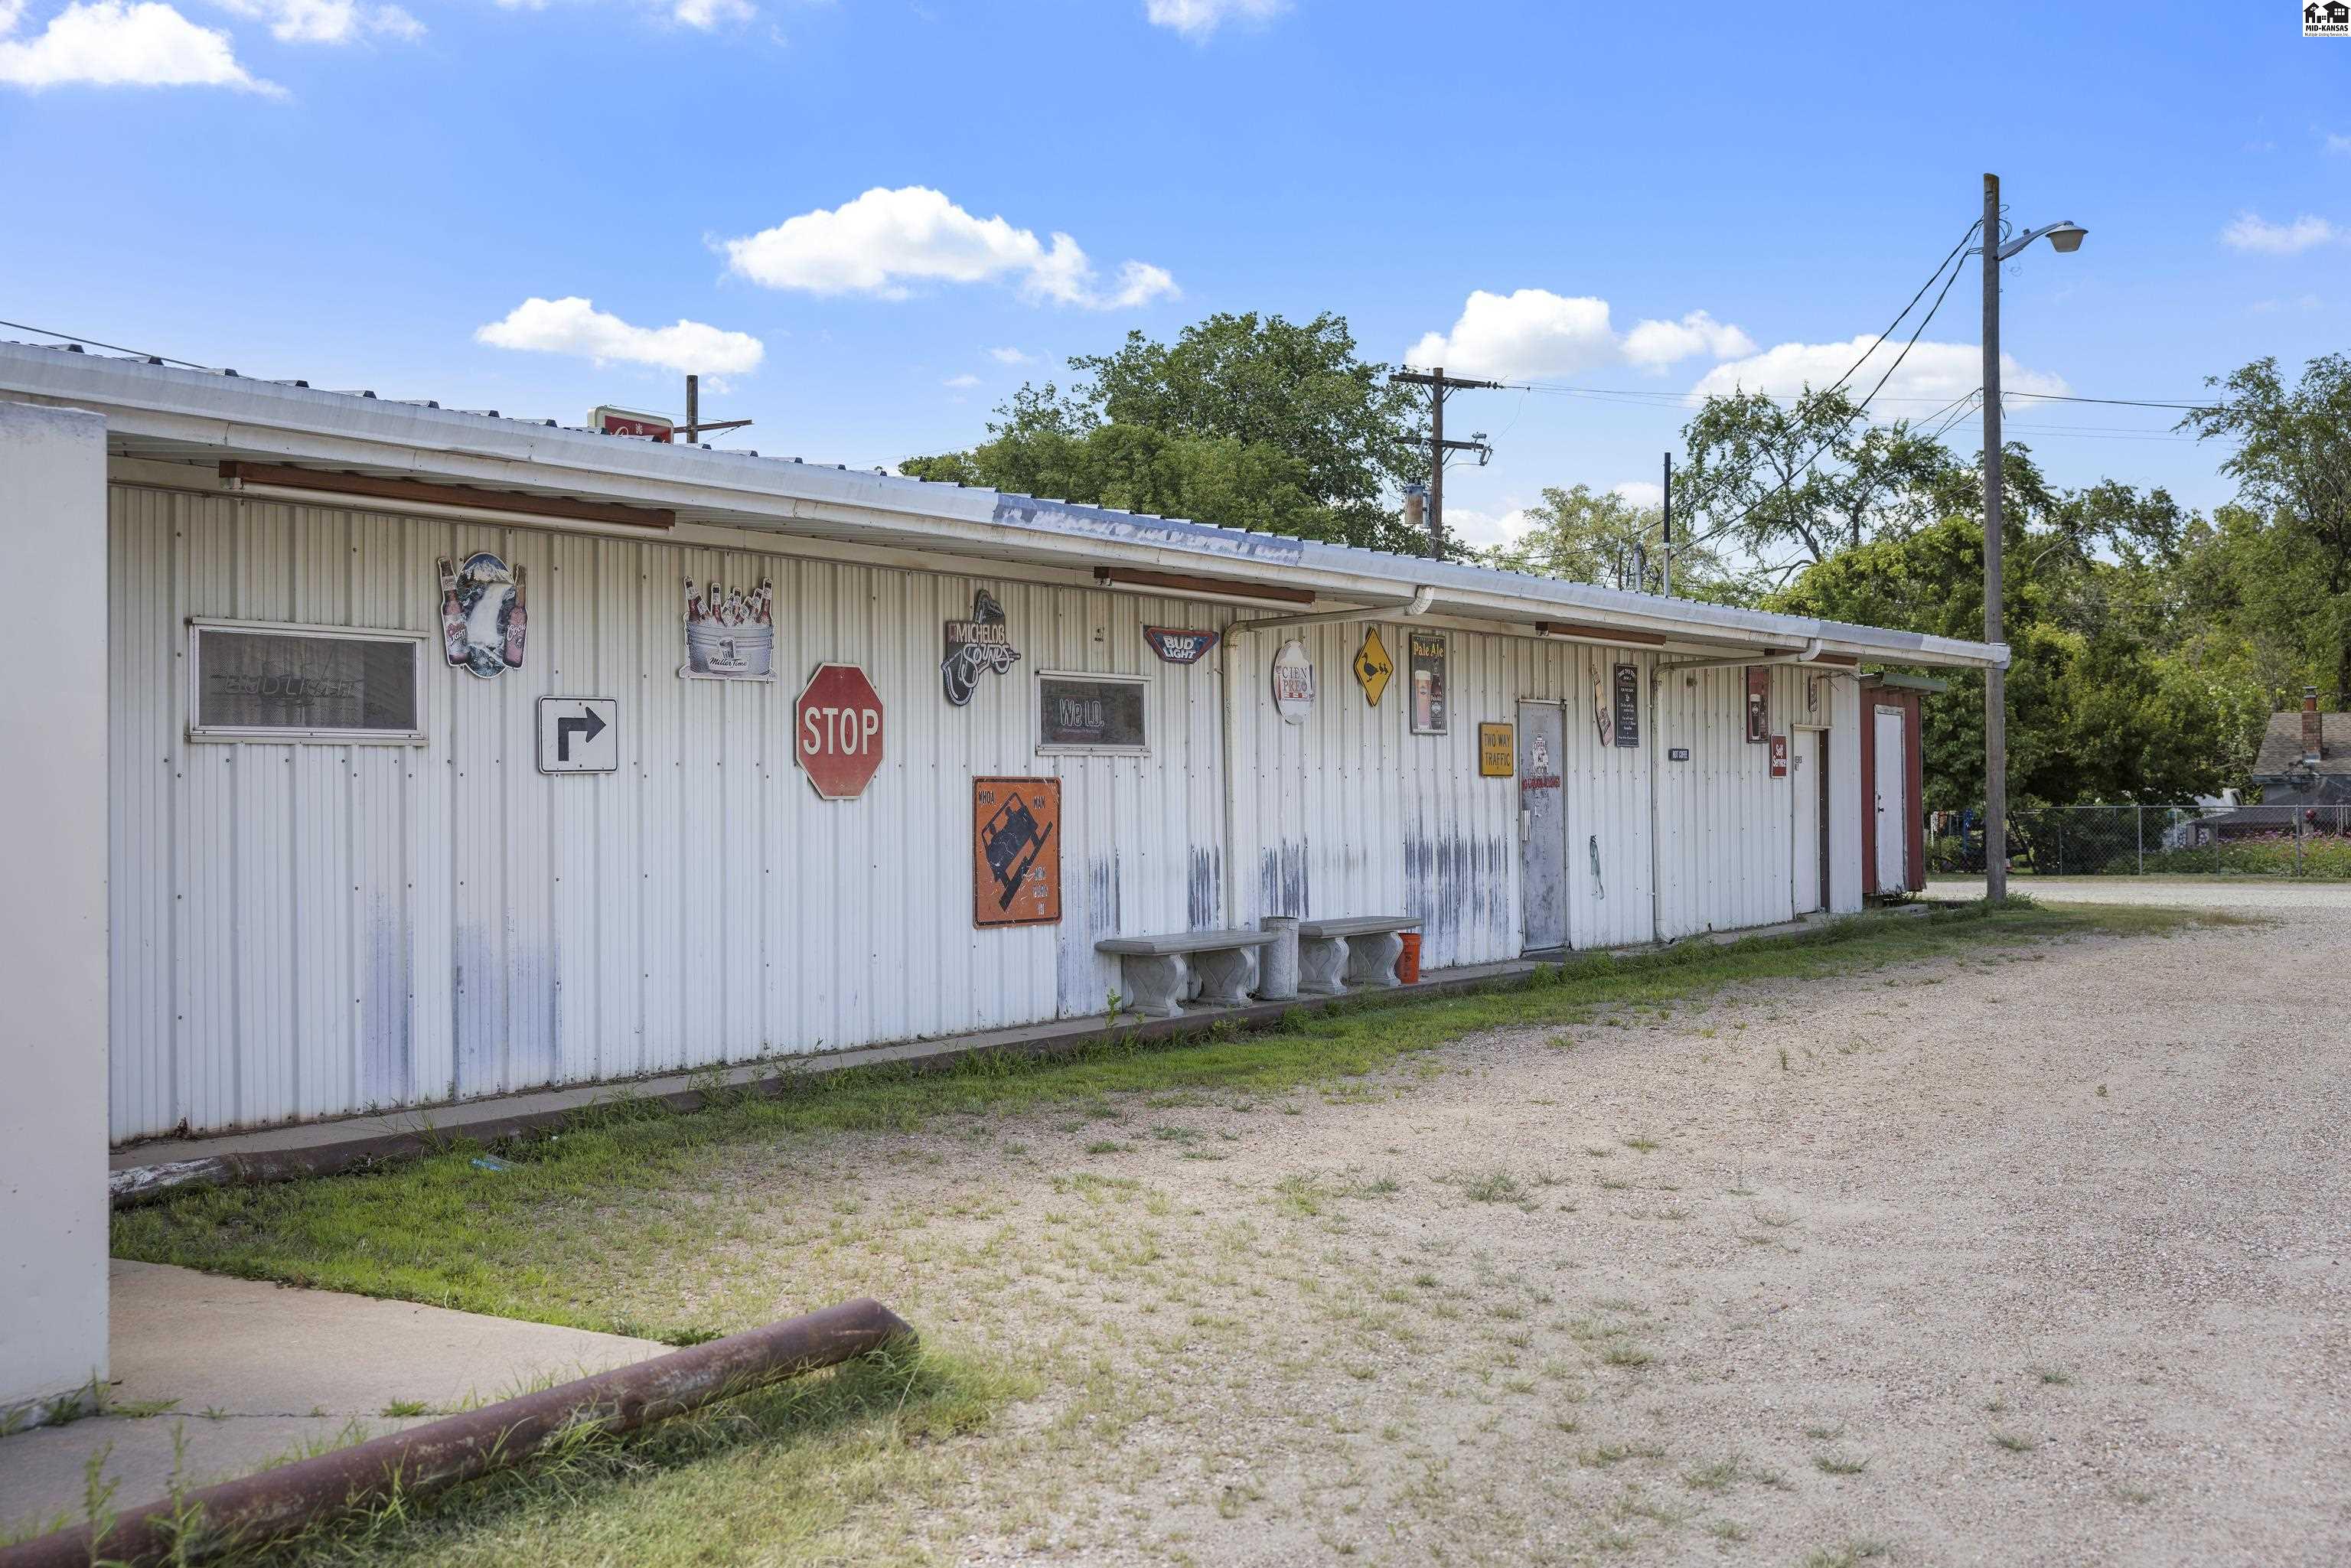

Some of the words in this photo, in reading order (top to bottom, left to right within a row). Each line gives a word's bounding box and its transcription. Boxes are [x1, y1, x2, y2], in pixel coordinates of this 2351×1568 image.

[507, 624, 527, 642] Coors
[957, 622, 1006, 644] MICHELOB
[1163, 635, 1194, 650] BUD
[1414, 642, 1429, 657] Pale
[1430, 643, 1443, 657] Ale
[1163, 646, 1195, 659] LIGHT
[709, 657, 732, 667] Miller
[731, 658, 748, 667] Time
[1059, 697, 1083, 727] We
[804, 706, 879, 755] STOP
[1485, 734, 1496, 748] TWO
[1498, 734, 1511, 748] WAY
[1485, 752, 1511, 767] TRAFFIC
[979, 791, 995, 804] WHOA
